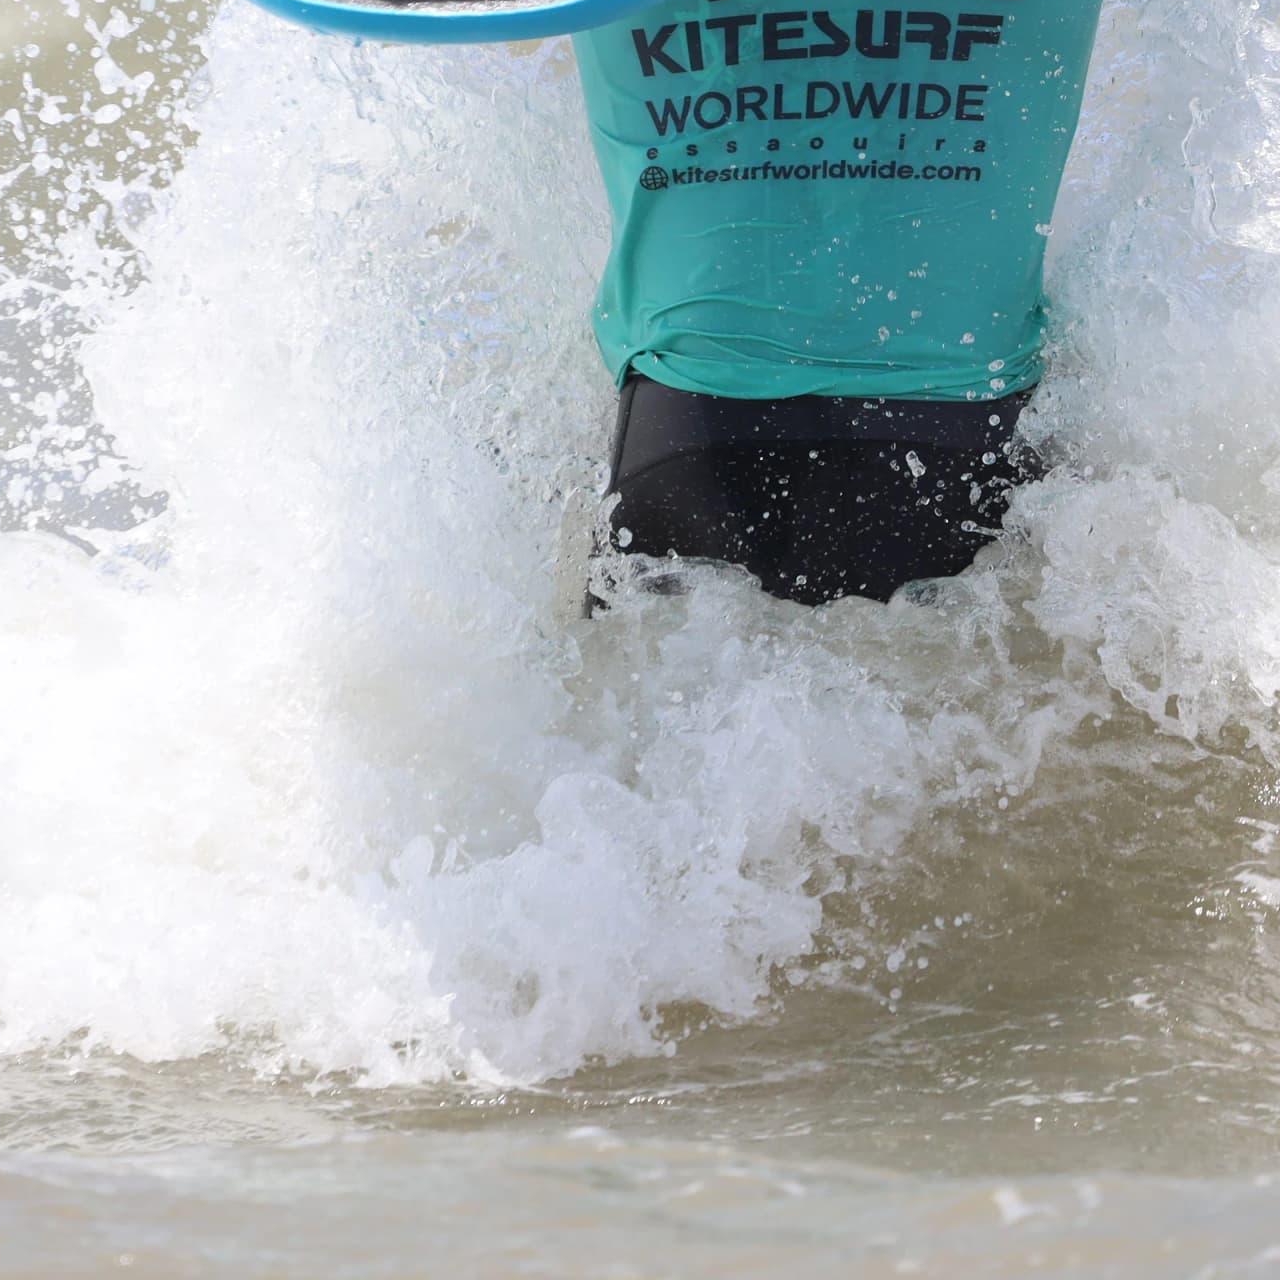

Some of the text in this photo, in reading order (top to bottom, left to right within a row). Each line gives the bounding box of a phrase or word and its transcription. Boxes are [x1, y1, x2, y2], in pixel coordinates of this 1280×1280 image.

[631, 9, 1004, 76] KITESURF
[645, 81, 989, 136] WORLDWIDE
[671, 159, 982, 184] kitesurfworldwide.com
